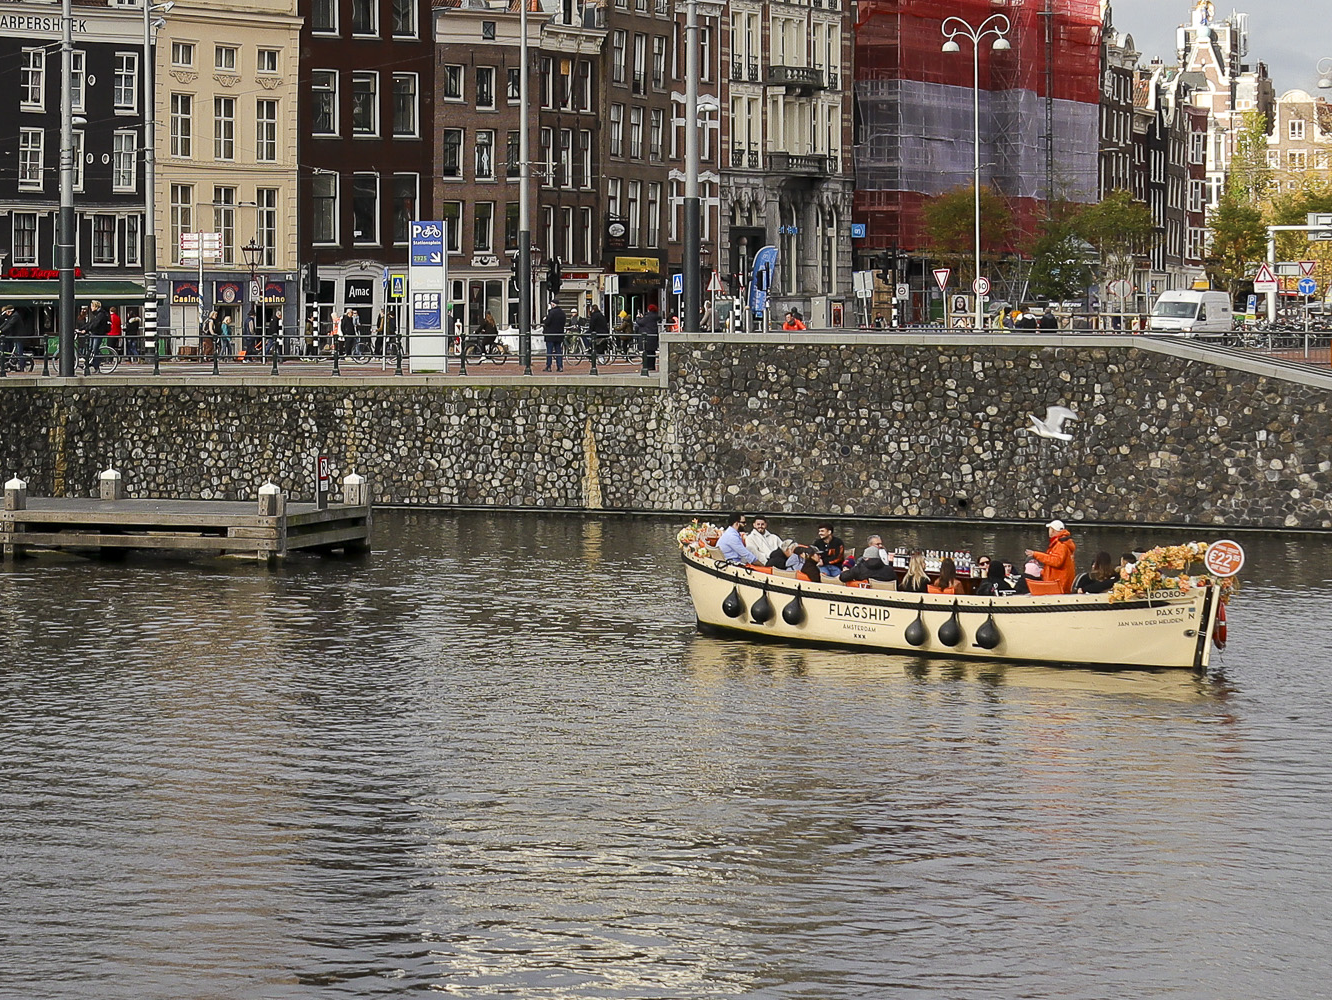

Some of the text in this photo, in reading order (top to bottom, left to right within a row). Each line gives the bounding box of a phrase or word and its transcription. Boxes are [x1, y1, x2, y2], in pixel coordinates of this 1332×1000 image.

[348, 285, 370, 298] Amac
[829, 603, 891, 621] FLAGSHIP
[1156, 608, 1173, 617] PAX
[842, 623, 877, 633] AMSTERDAM
